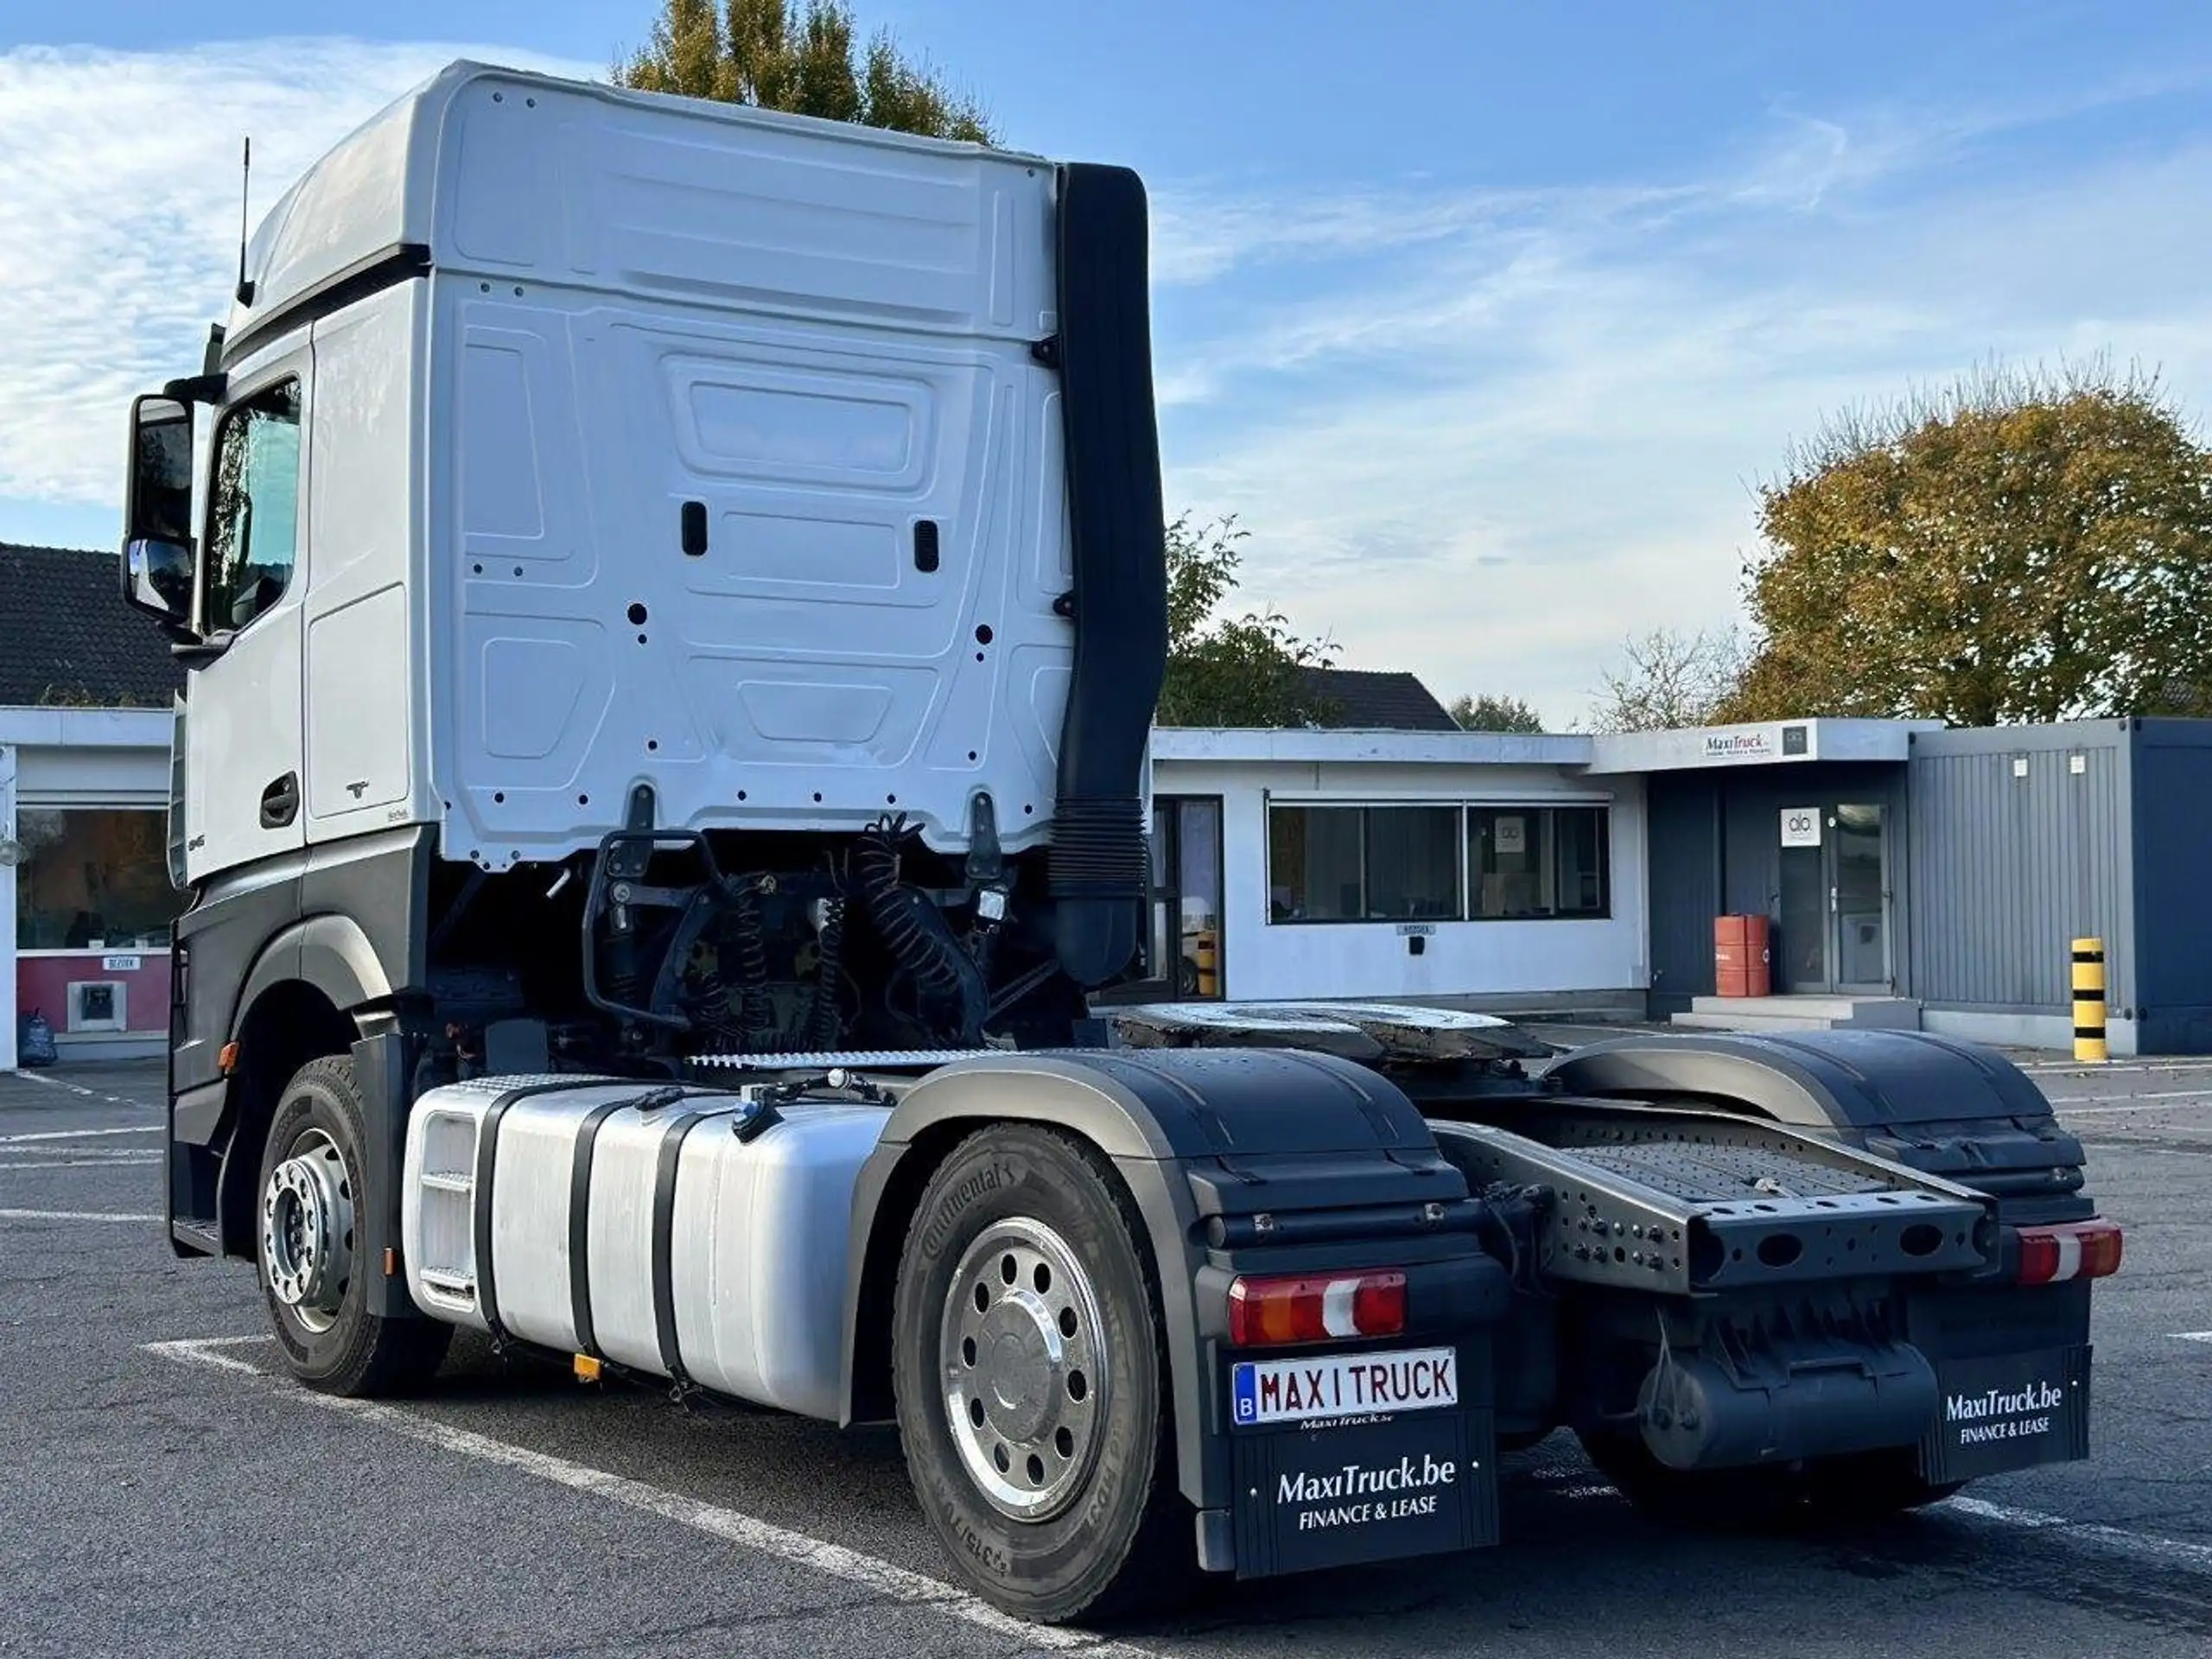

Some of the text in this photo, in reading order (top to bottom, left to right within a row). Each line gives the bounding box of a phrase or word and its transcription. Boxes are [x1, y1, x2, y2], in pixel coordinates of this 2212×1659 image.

[1241, 1398, 1253, 1416] B
[1946, 1381, 2063, 1422] MaxiTruck.be
[1961, 1416, 2050, 1445] FINANCE & LEASE
[1276, 1453, 1456, 1504] MaxiTruck.be
[1299, 1495, 1438, 1531] FINANCE & LEASE
